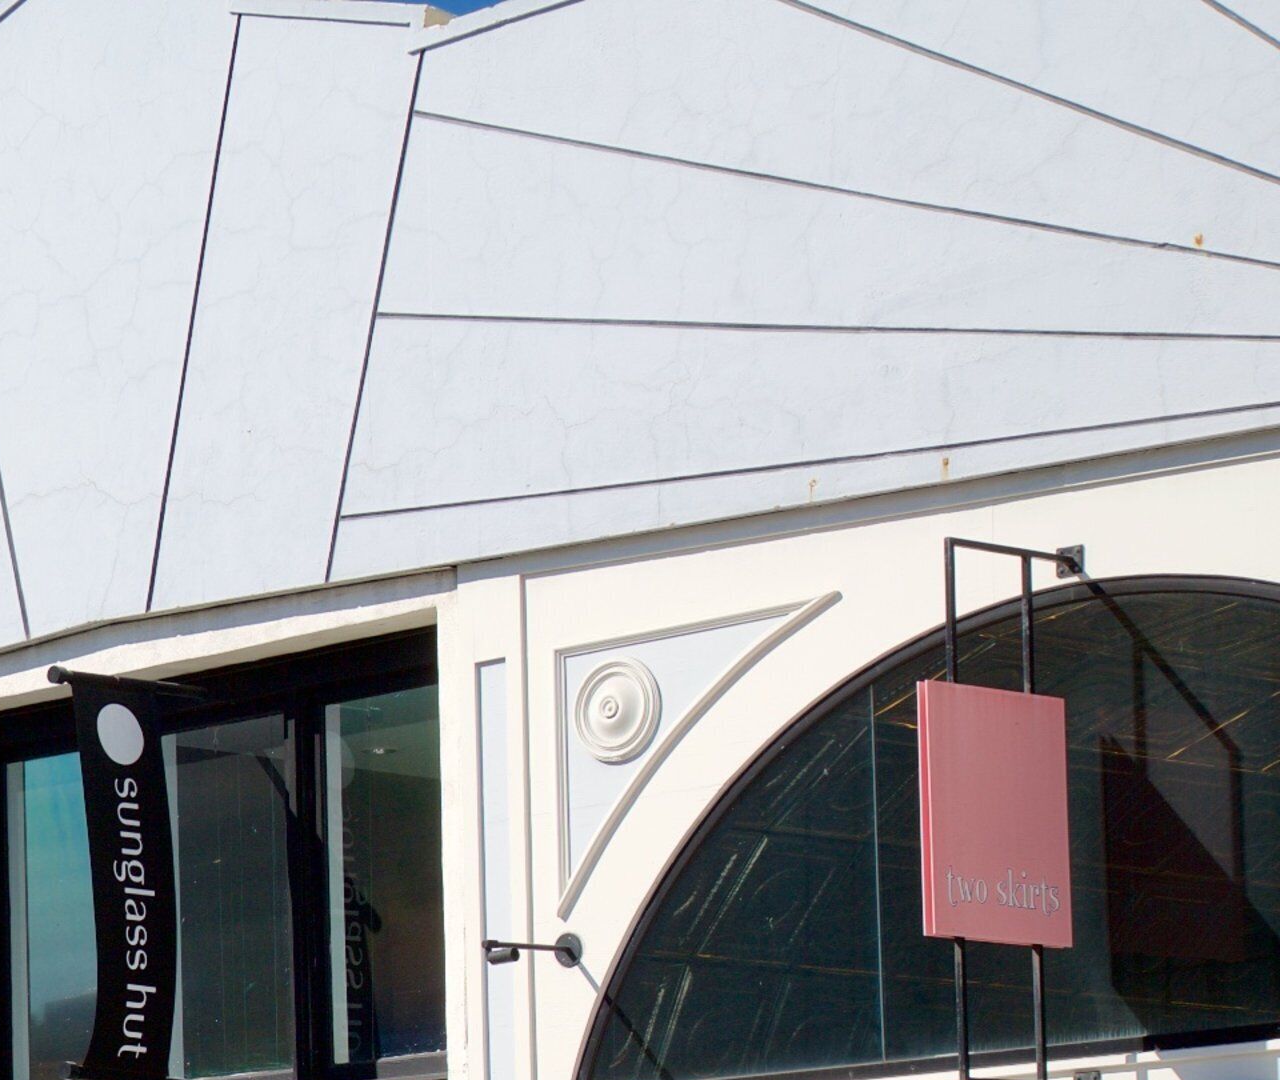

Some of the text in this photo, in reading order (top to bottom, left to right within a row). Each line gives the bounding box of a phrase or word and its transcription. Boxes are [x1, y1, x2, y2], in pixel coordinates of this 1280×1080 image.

[112, 777, 158, 1060] sunglass hut
[946, 866, 1061, 915] two skirts
